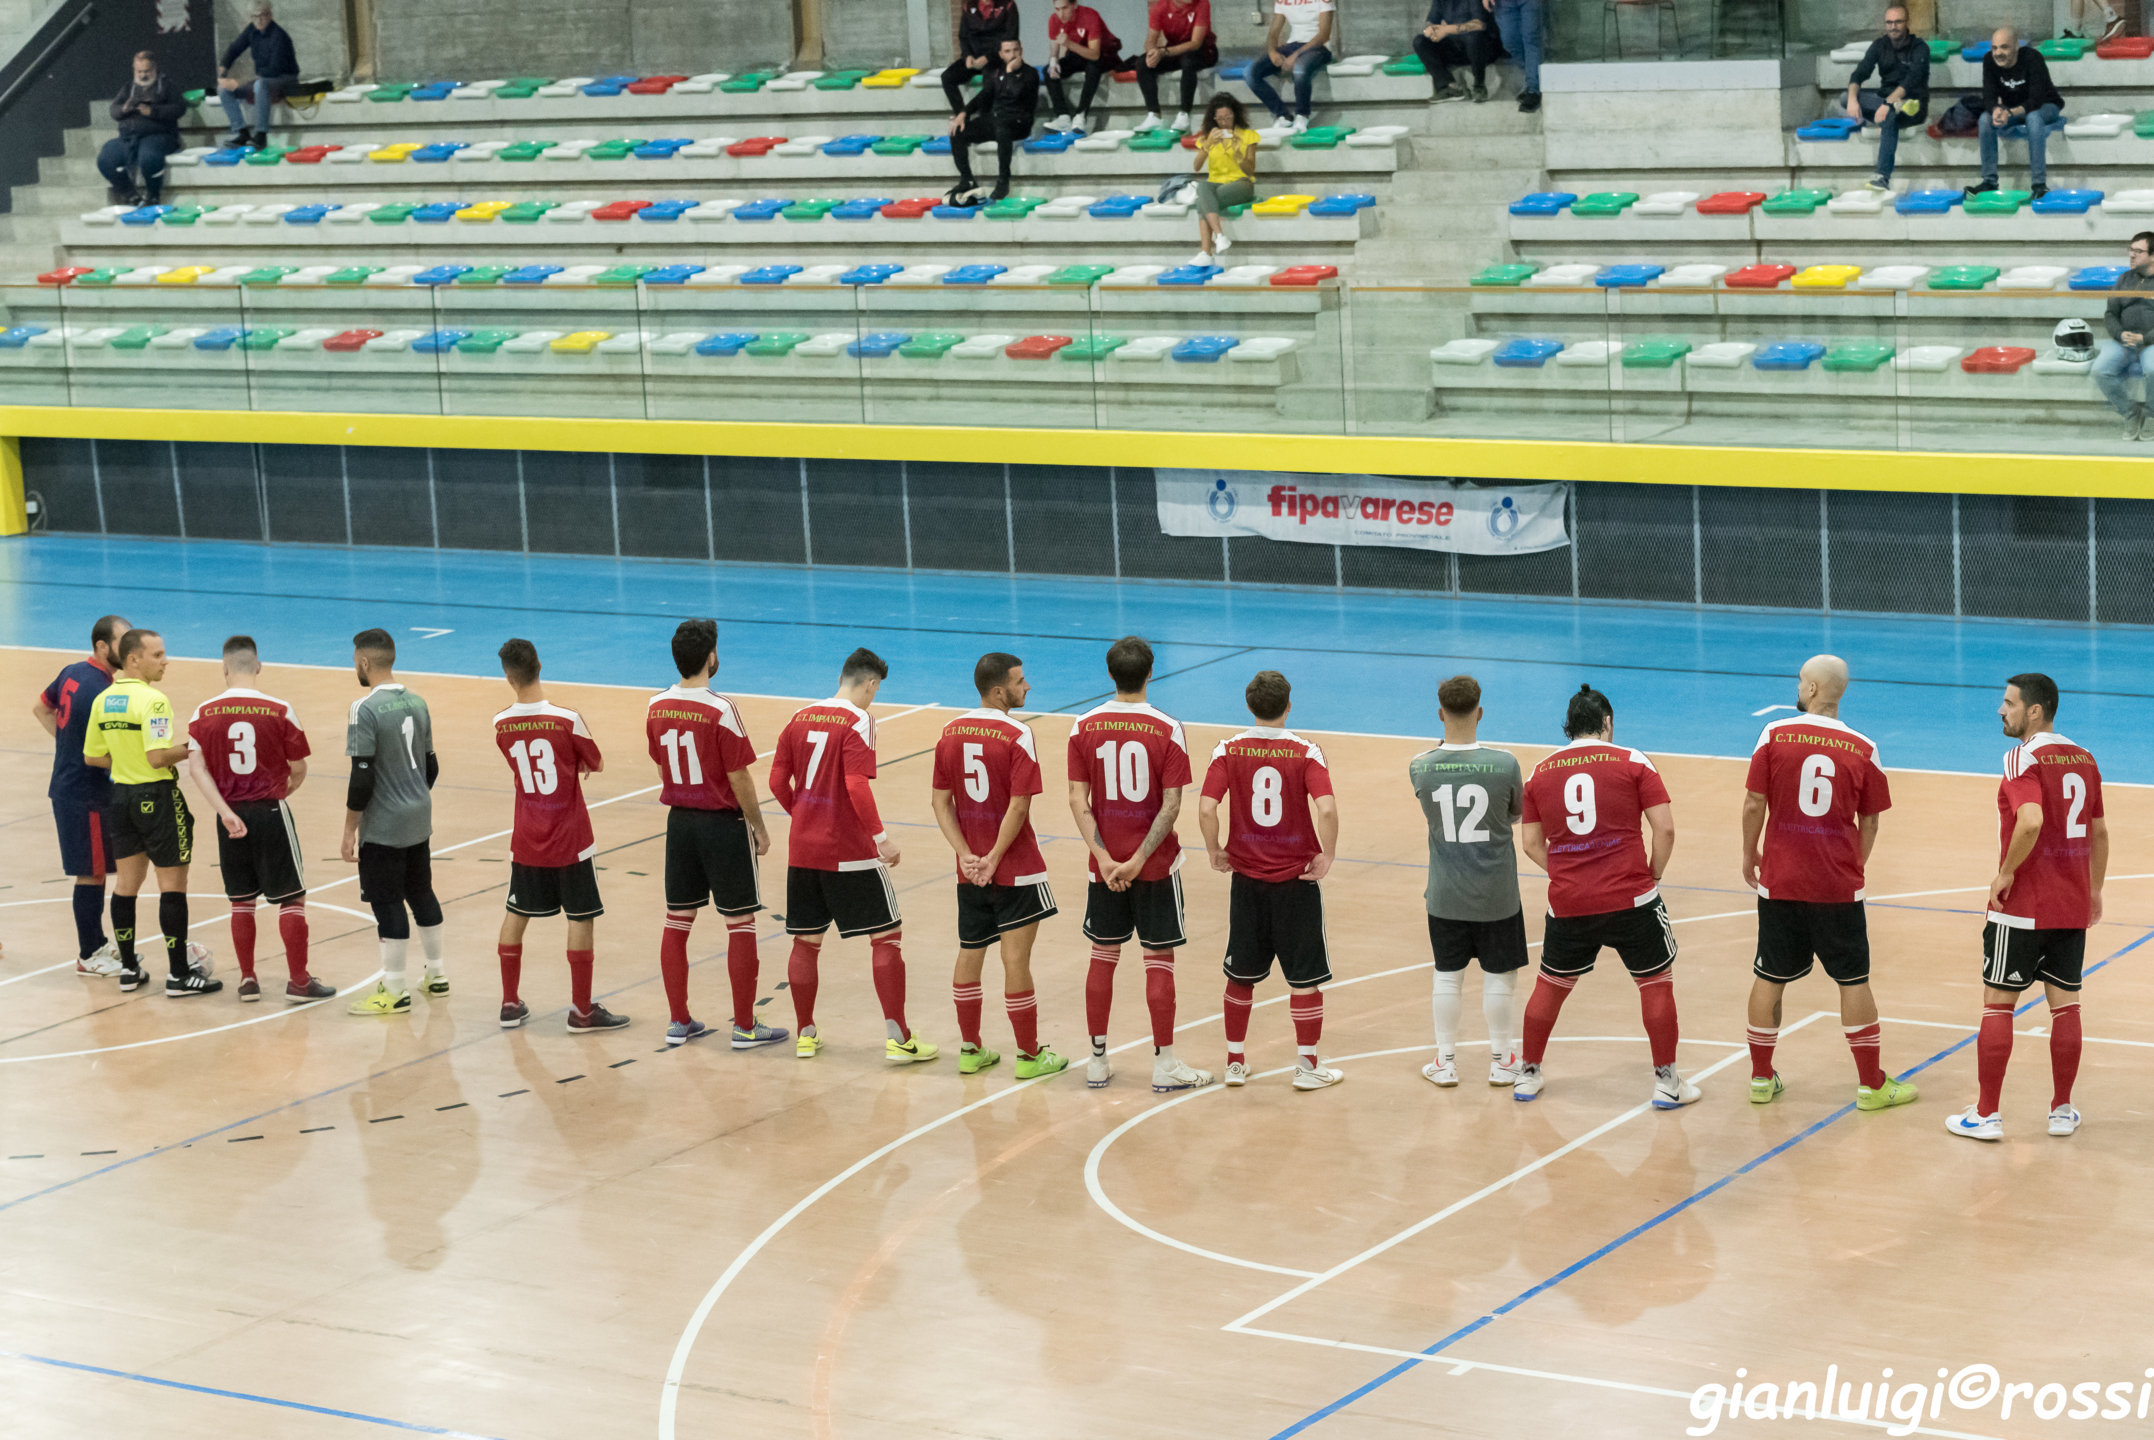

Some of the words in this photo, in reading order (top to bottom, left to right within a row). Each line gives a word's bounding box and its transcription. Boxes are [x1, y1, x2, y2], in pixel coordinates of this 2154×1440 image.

[1267, 485, 1454, 527] fipavarese
[56, 677, 80, 730] 5
[228, 721, 257, 775] 3
[401, 715, 418, 770] 1
[508, 738, 558, 795] 13
[660, 728, 704, 785] 11
[805, 730, 829, 790] 7
[963, 742, 990, 803] 5
[1095, 740, 1150, 803] 10
[1251, 765, 1283, 828] 8
[1431, 783, 1490, 844] 12
[1563, 772, 1597, 836] 9
[1798, 753, 1836, 818] 6
[2062, 772, 2087, 839] 2
